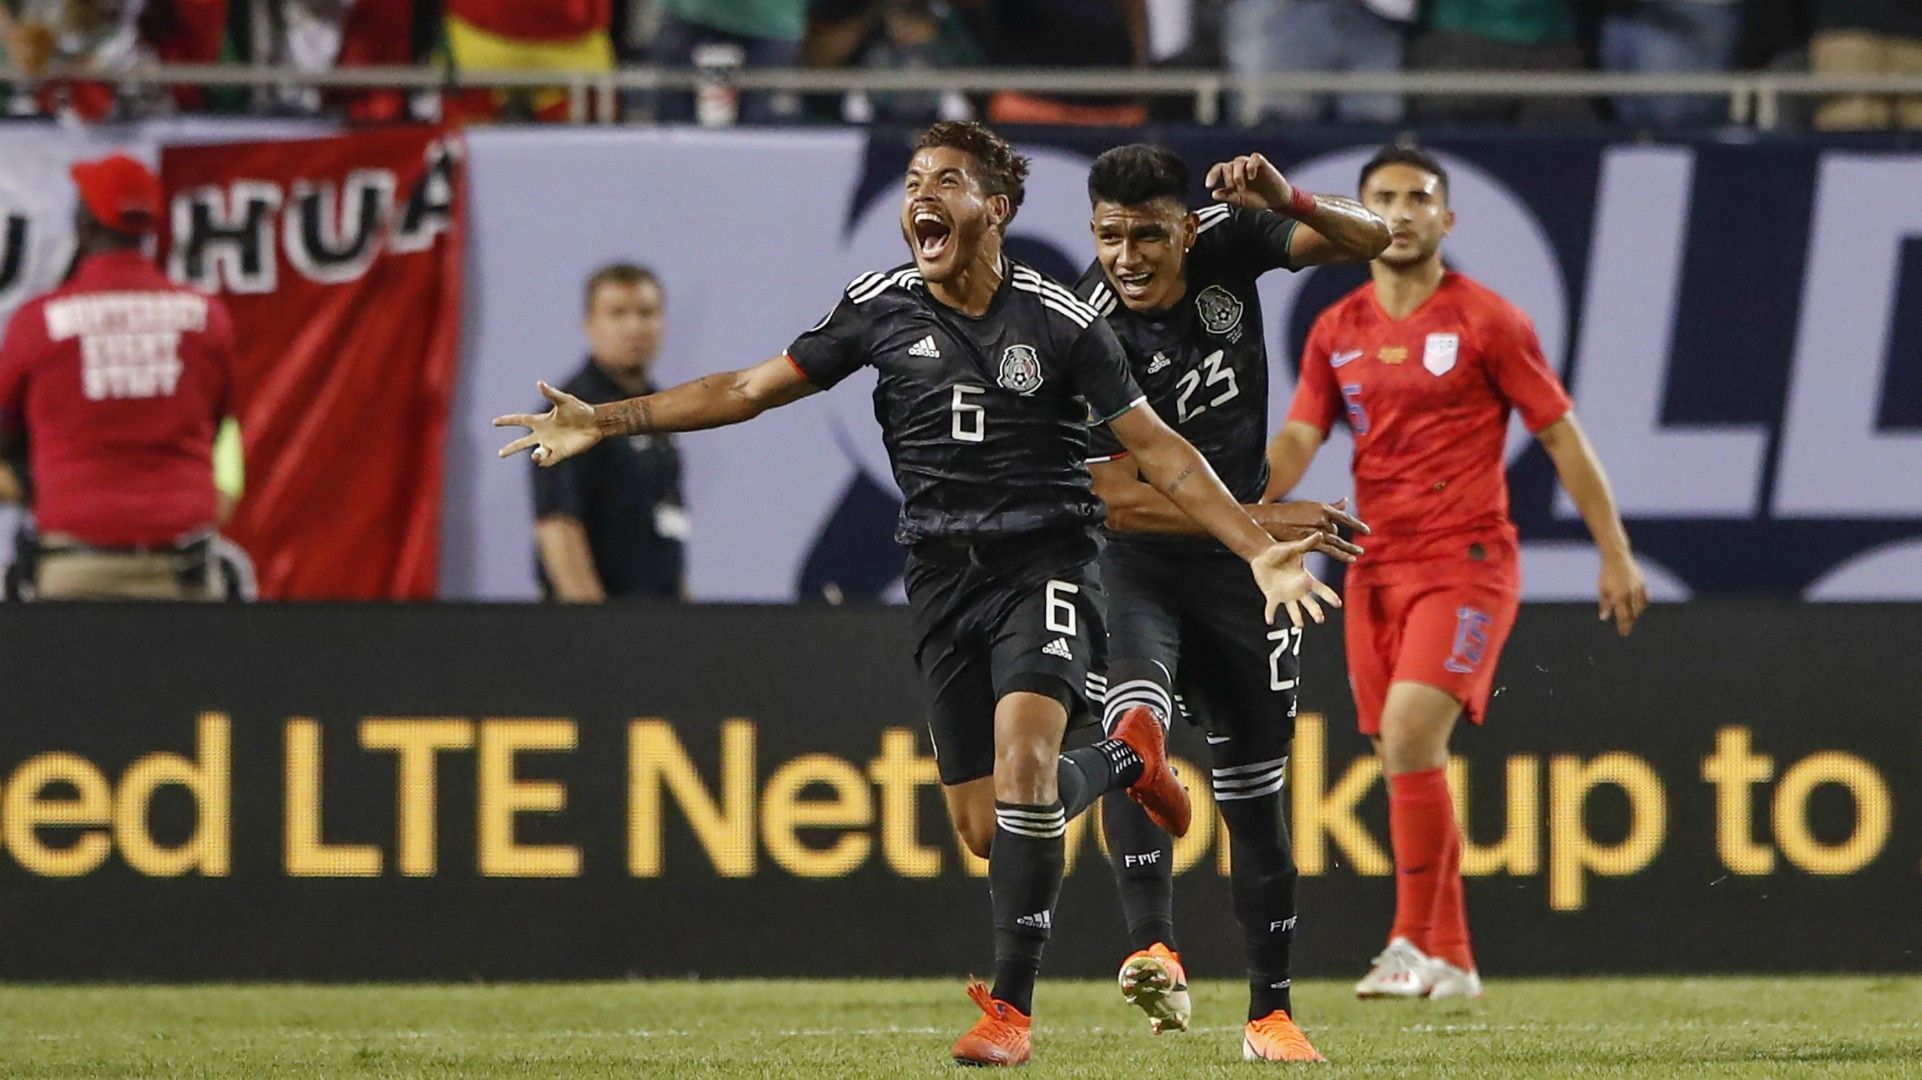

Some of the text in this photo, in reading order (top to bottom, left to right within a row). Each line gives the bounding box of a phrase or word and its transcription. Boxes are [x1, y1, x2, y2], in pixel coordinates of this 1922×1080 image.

[951, 384, 986, 443] 6
[1175, 349, 1240, 424] 23
[1045, 579, 1079, 636] 6
[0, 711, 1893, 911] ed LTE Netk up to
[1124, 849, 1162, 869] FMF
